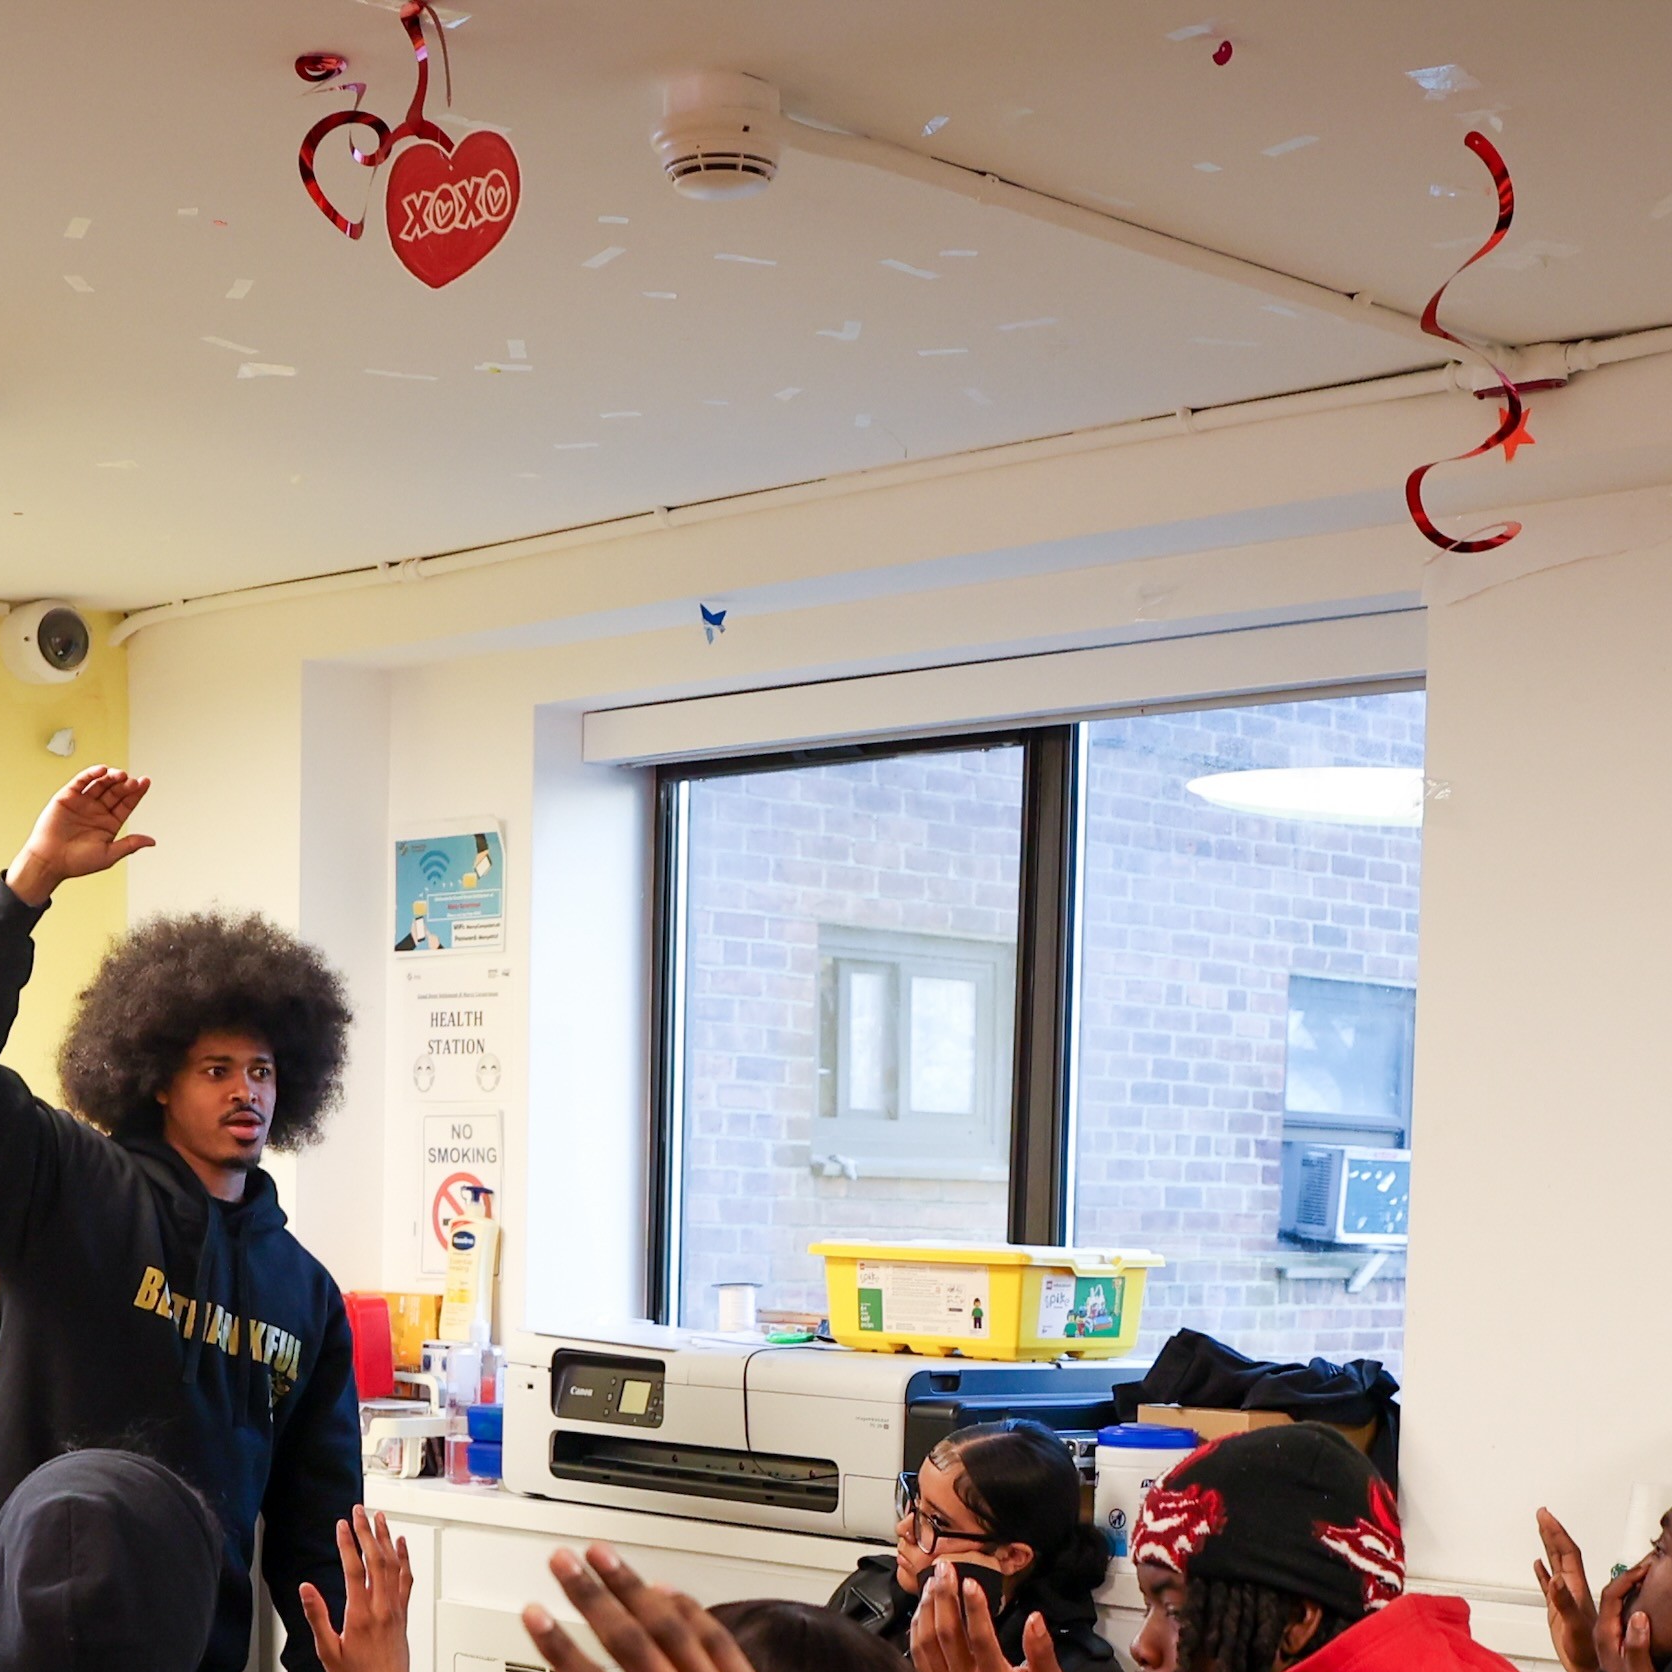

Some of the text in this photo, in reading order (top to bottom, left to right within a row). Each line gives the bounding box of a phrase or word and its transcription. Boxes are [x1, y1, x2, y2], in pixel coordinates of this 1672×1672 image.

[399, 168, 511, 242] XOXO
[430, 1011, 483, 1028] HEALTH
[427, 1038, 486, 1055] STATION
[451, 1123, 473, 1140] NO
[428, 1147, 497, 1164] SMOKING
